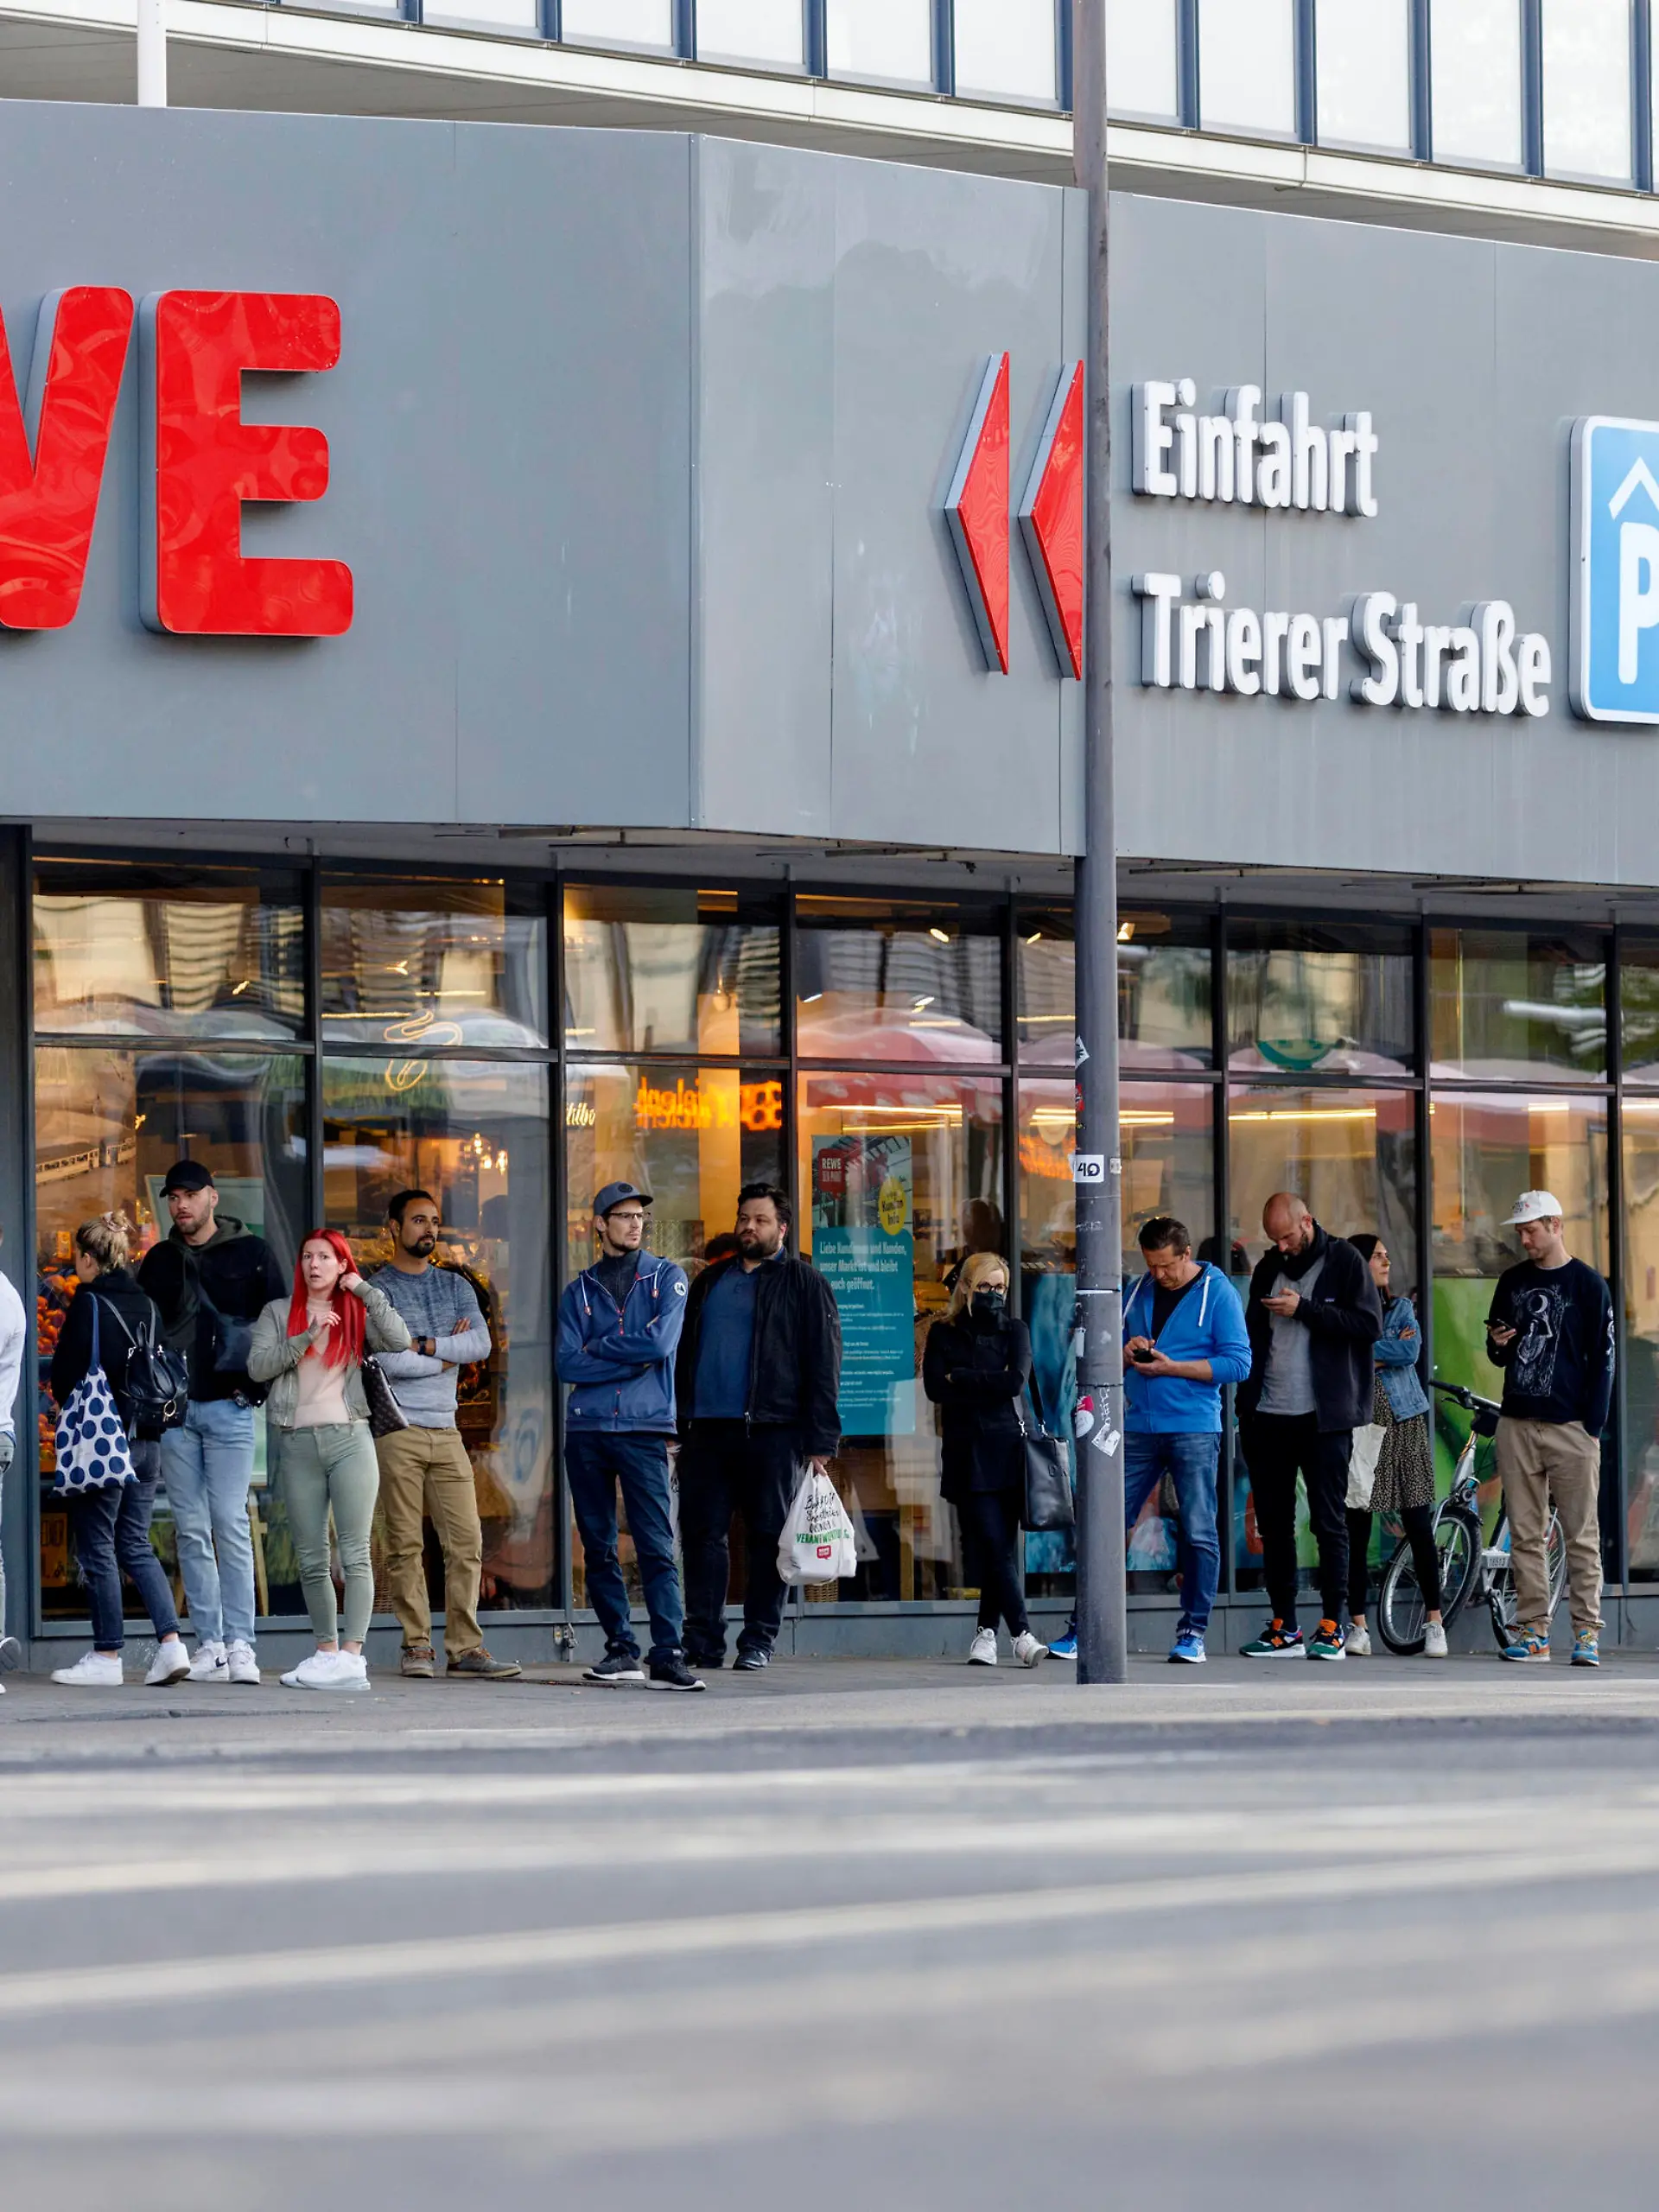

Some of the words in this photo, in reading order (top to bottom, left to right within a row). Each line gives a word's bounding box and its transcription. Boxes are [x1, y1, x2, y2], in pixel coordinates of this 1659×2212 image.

[1132, 378, 1378, 518] Einfahrt
[1133, 570, 1349, 702] Trierer
[1351, 591, 1552, 717] Straße
[1618, 521, 1659, 684] P
[822, 1157, 842, 1169] REWE
